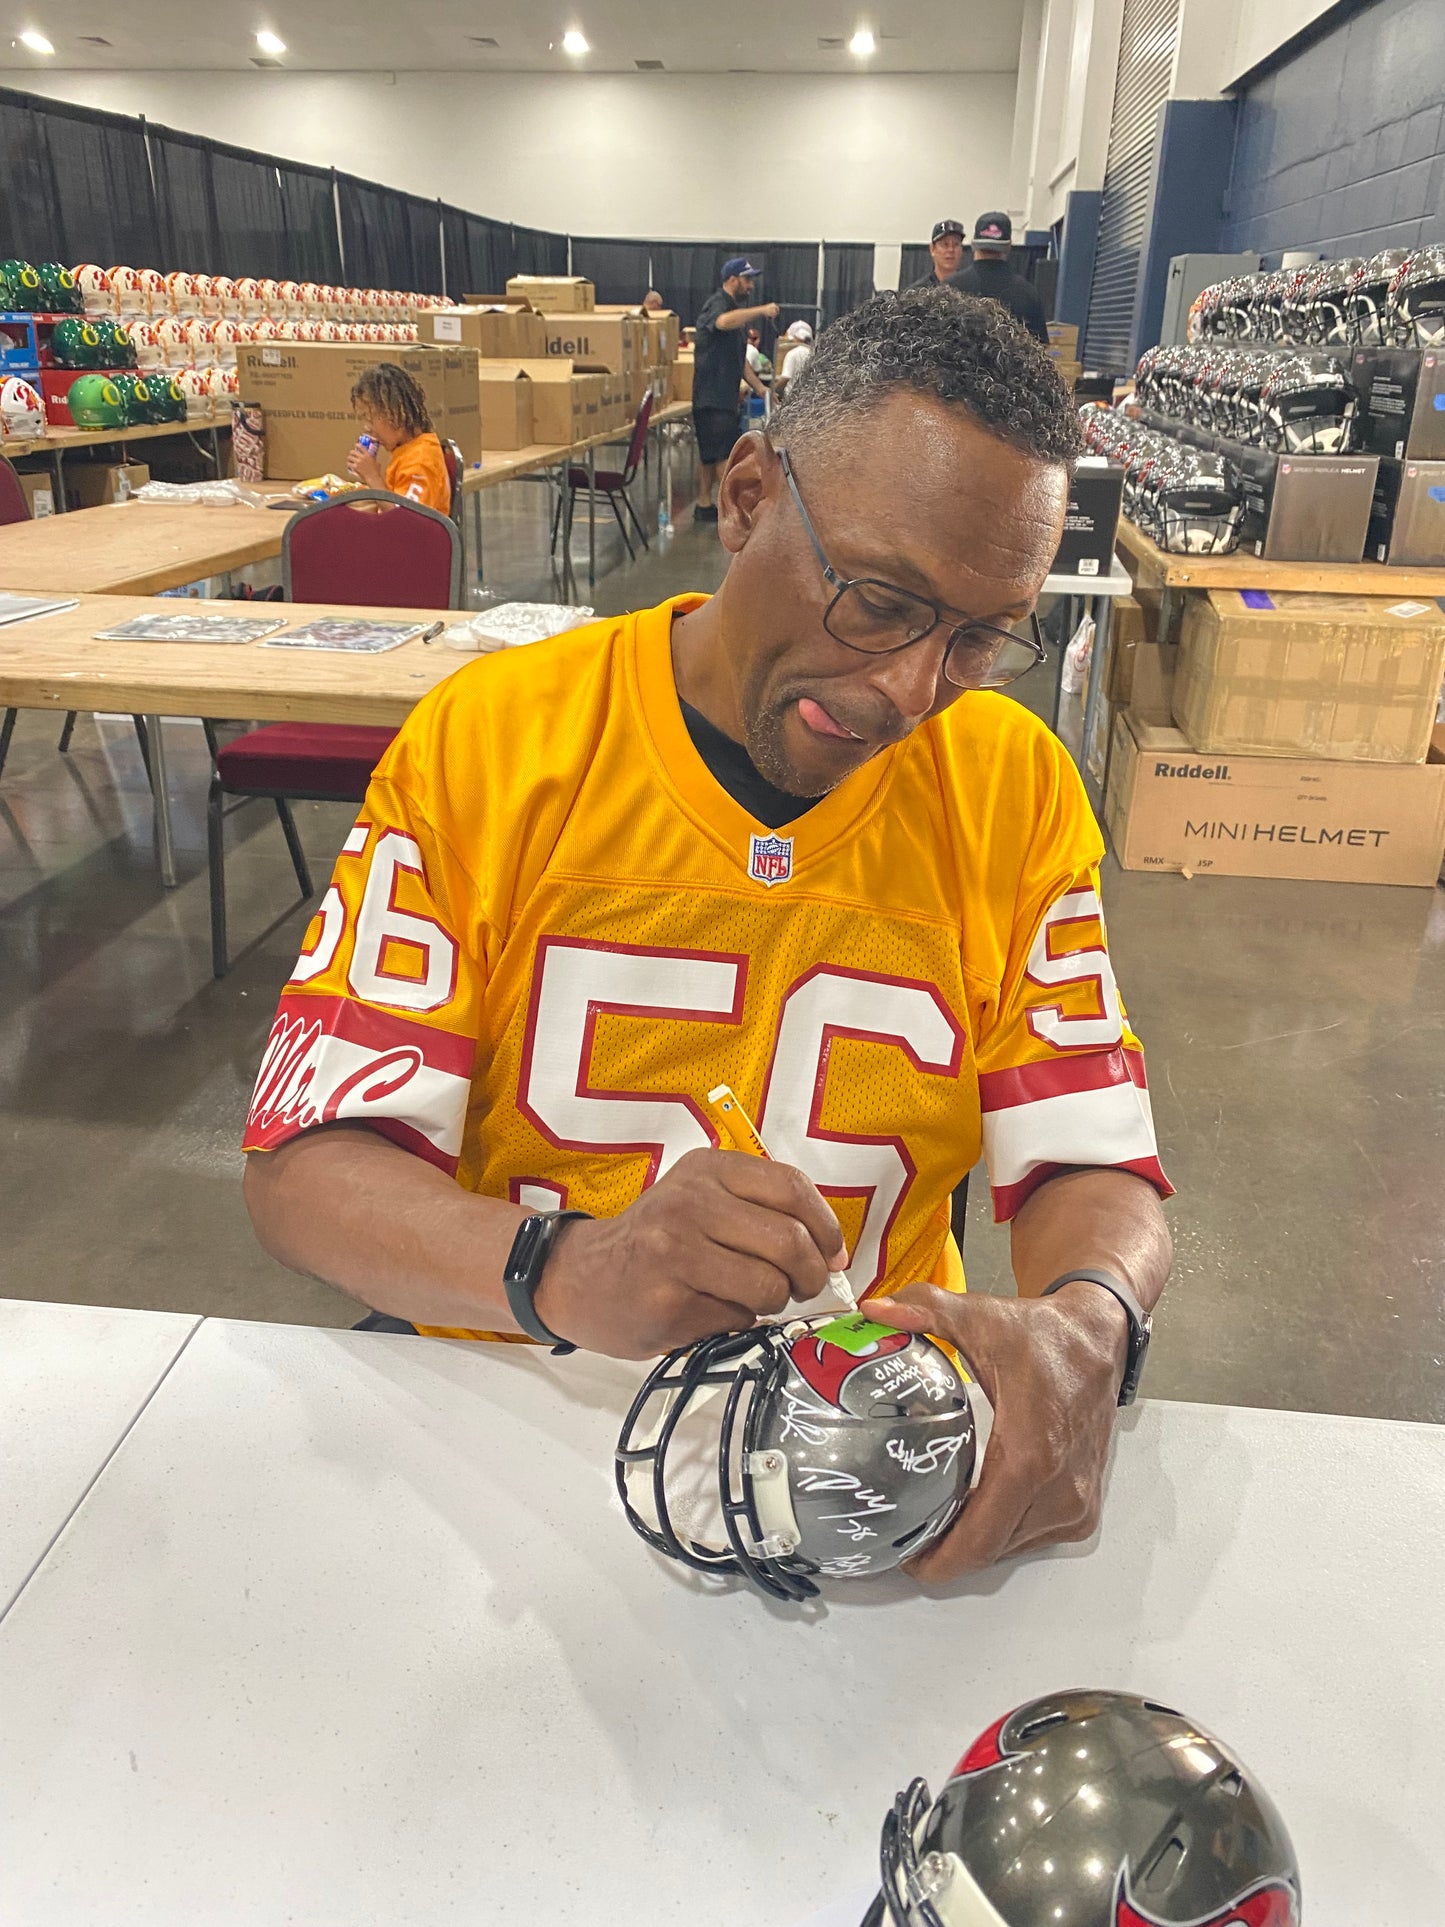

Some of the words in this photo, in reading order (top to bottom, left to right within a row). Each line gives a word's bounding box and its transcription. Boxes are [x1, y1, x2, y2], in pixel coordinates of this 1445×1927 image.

[1184, 820, 1247, 841] MINI
[1253, 823, 1390, 848] HELMET
[755, 855, 787, 878] NFL
[1143, 856, 1165, 865] RMX
[509, 934, 967, 1312] 56
